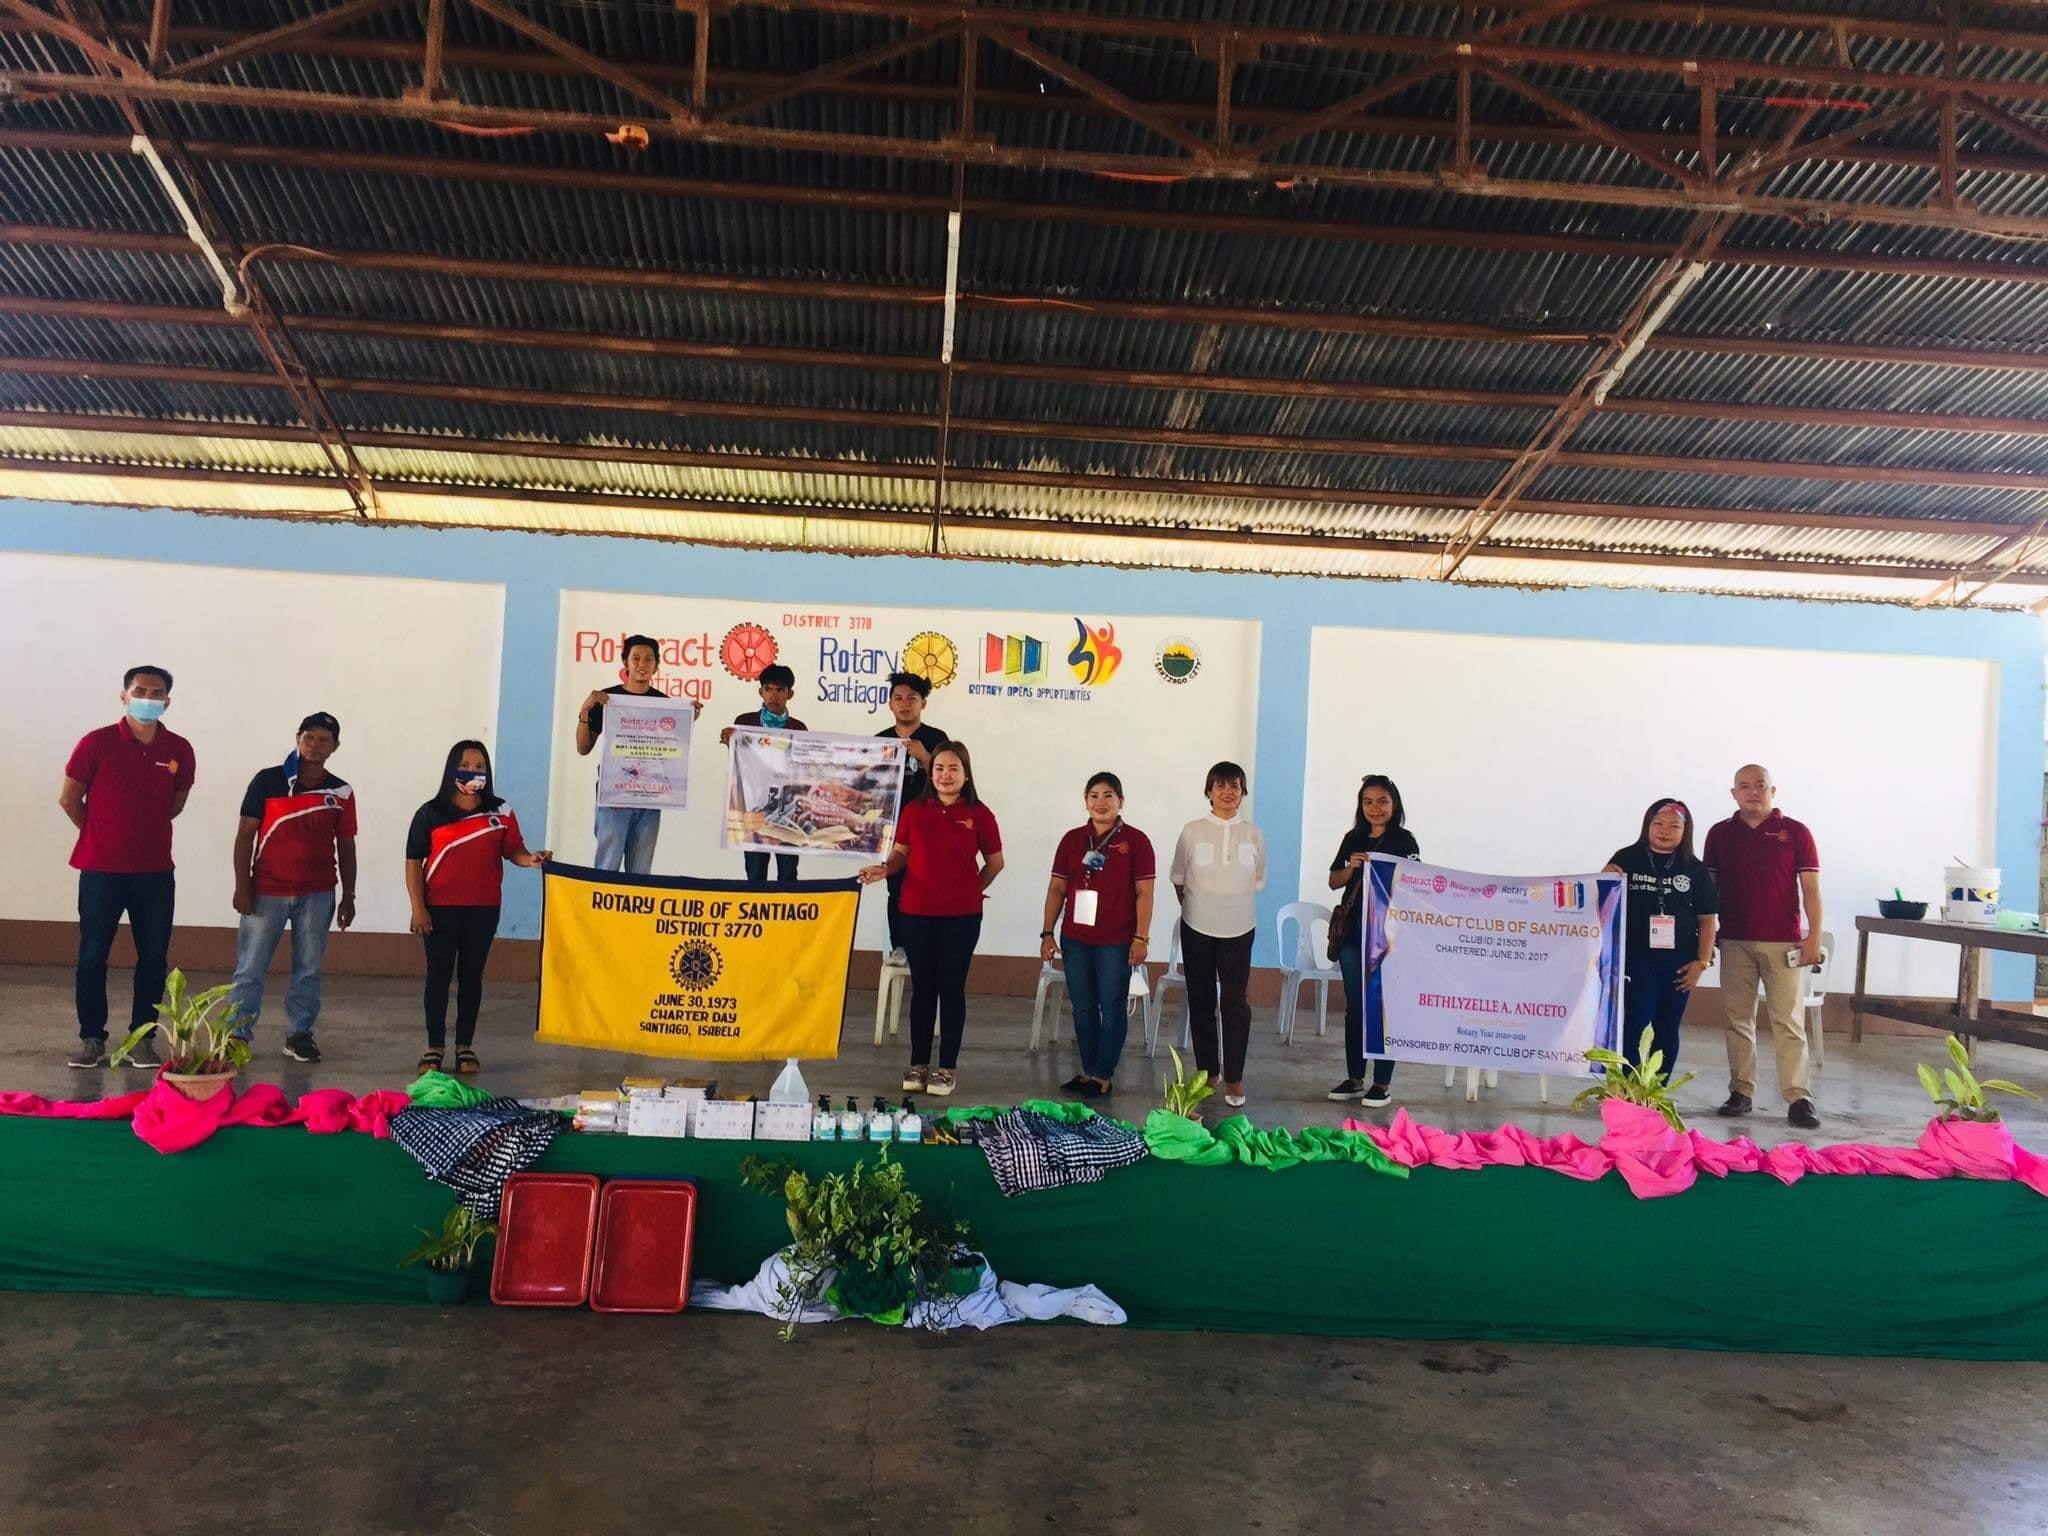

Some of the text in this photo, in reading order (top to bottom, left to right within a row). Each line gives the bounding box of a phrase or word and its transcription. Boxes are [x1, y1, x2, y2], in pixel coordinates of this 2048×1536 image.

[783, 614, 840, 629] DISTRICT
[819, 637, 898, 674] Rotary
[817, 676, 889, 714] Santiago
[968, 684, 1002, 696] ROTARY
[1036, 688, 1091, 701] OPPORTUNITIES
[1632, 872, 1672, 885] Rotarct
[1502, 886, 1528, 896] Rotary
[592, 891, 819, 920] ROTARY CLUB OF SANTIAGO
[656, 919, 763, 938] DISTRICT 3770
[1388, 908, 1599, 938] ROTARACT CLUB OF SANTIAGO
[1459, 934, 1483, 945] CLUB
[1496, 938, 1527, 948] 215076
[1489, 949, 1512, 959] JUNE
[1528, 952, 1549, 961] 2017
[654, 994, 685, 1006] JUNE
[1419, 993, 1567, 1018] BETHLYZELLE A. ANICETO
[650, 1009, 737, 1023] CHARTER DAY
[640, 1021, 740, 1037] SANTIAGO, ISABELA
[1457, 1026, 1478, 1039] Rotary
[1385, 1036, 1438, 1050] SPONSORED
[1454, 1042, 1493, 1055] ROTARY
[1493, 1046, 1520, 1058] CLUB
[1521, 1048, 1536, 1059] OF
